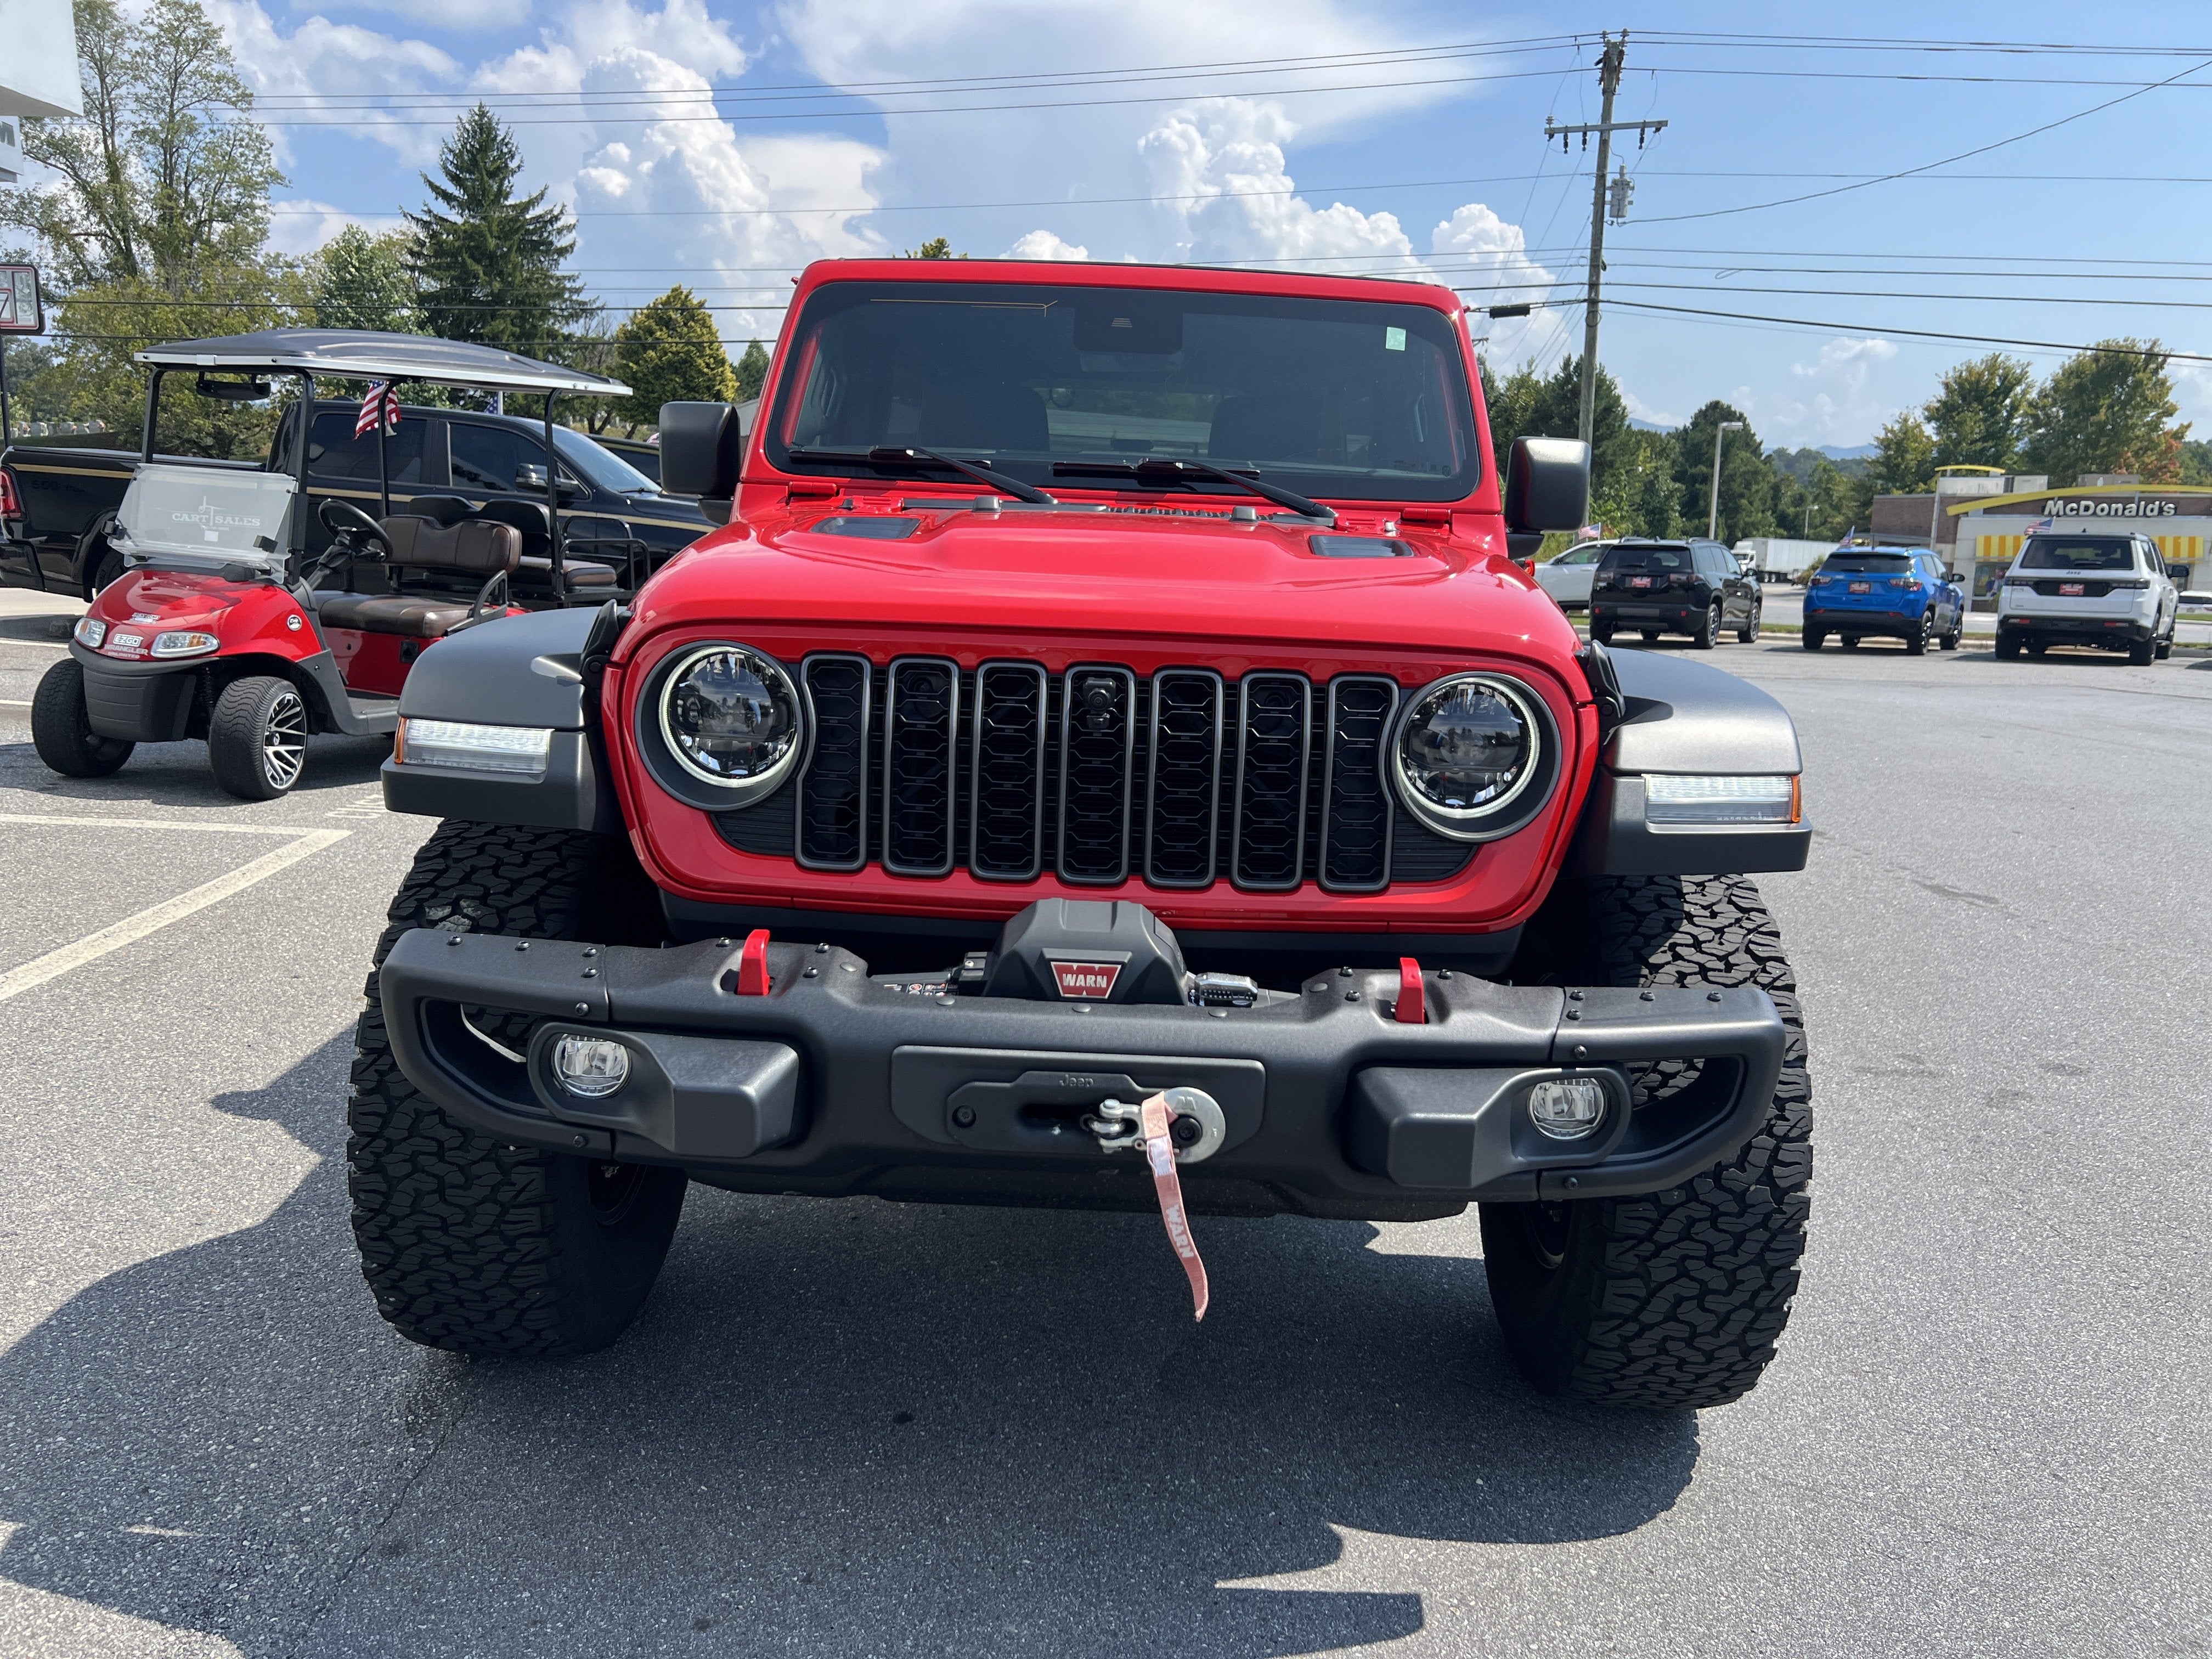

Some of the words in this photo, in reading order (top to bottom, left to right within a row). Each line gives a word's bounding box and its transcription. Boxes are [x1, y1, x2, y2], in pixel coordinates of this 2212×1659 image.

[2043, 500, 2177, 517] McDonald's
[172, 512, 209, 523] CART
[215, 515, 261, 527] SALES
[104, 644, 149, 656] WRANGLER
[1062, 973, 1108, 988] WARN
[1059, 1074, 1094, 1088] Jeep
[1165, 1203, 1194, 1259] WARN
